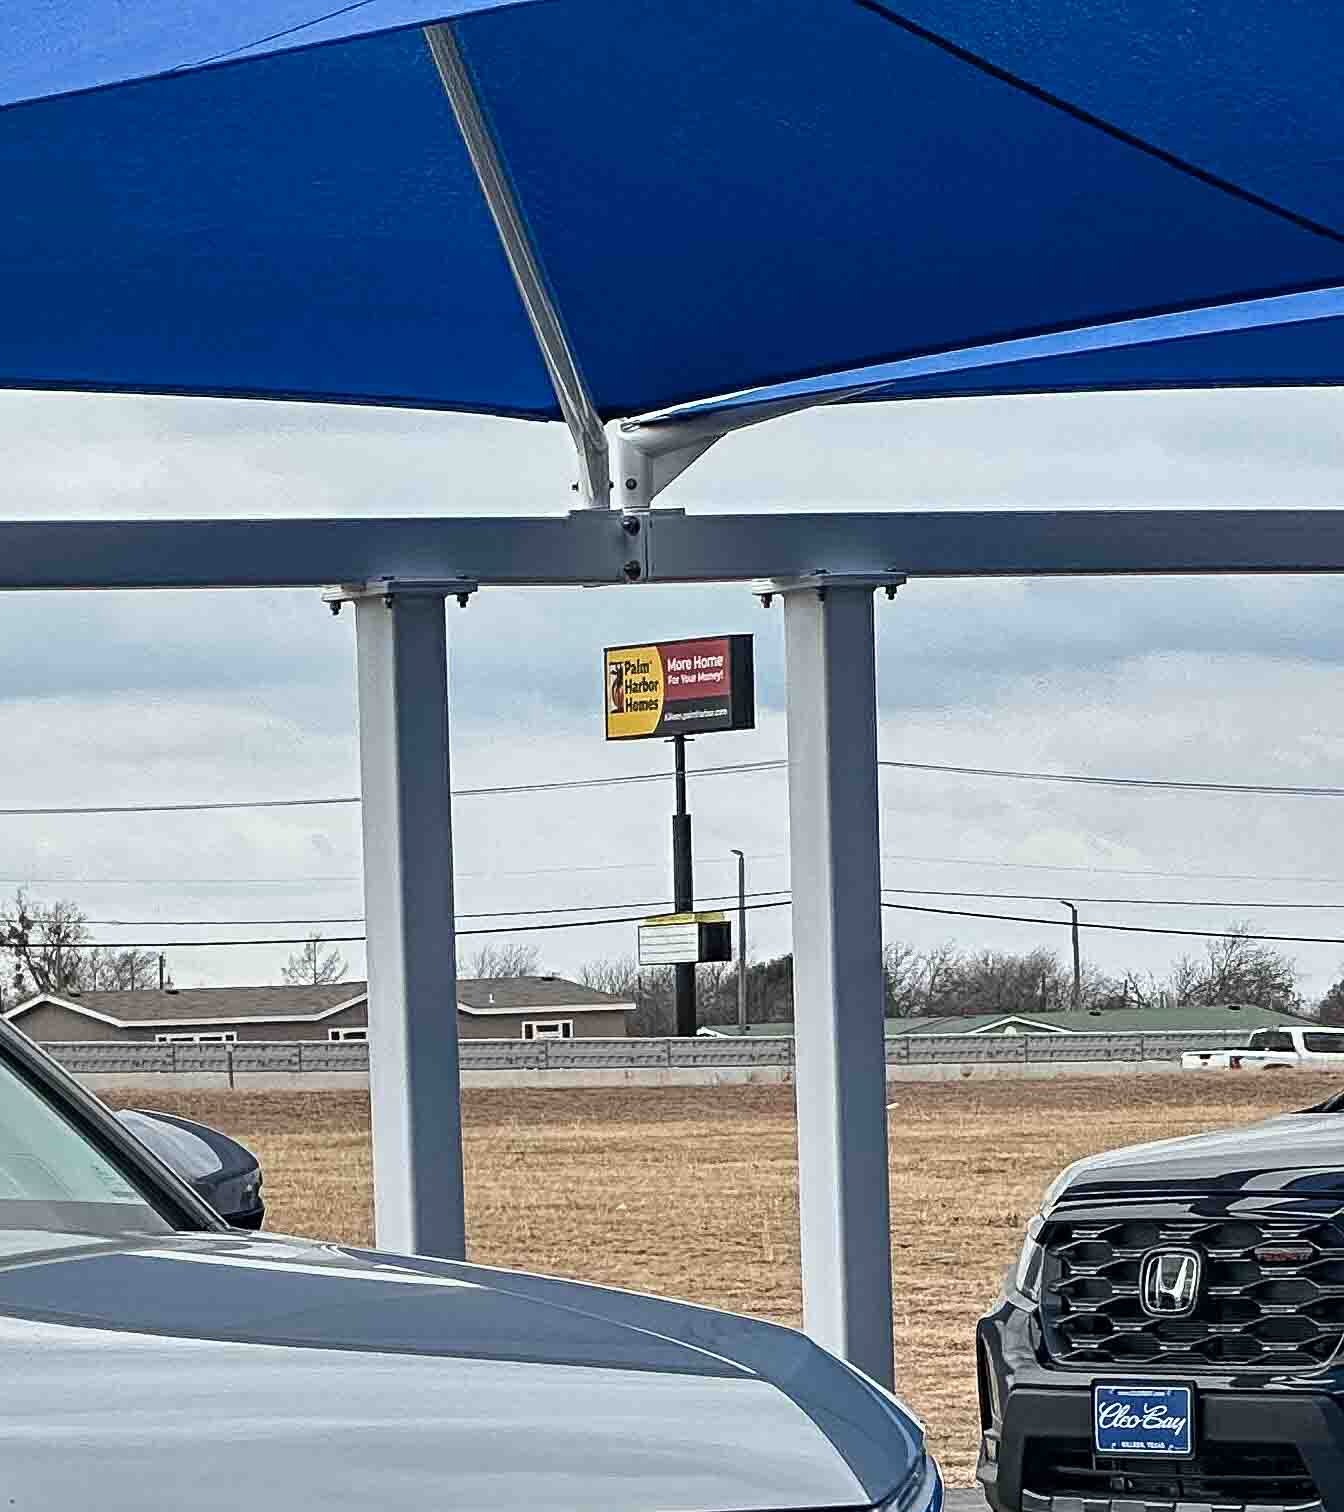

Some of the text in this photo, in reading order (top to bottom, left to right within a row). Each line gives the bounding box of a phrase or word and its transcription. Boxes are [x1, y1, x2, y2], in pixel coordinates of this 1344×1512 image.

[624, 659, 650, 675] Palm
[667, 655, 724, 672] More Home
[624, 678, 659, 695] Harbor
[625, 698, 659, 713] Homes
